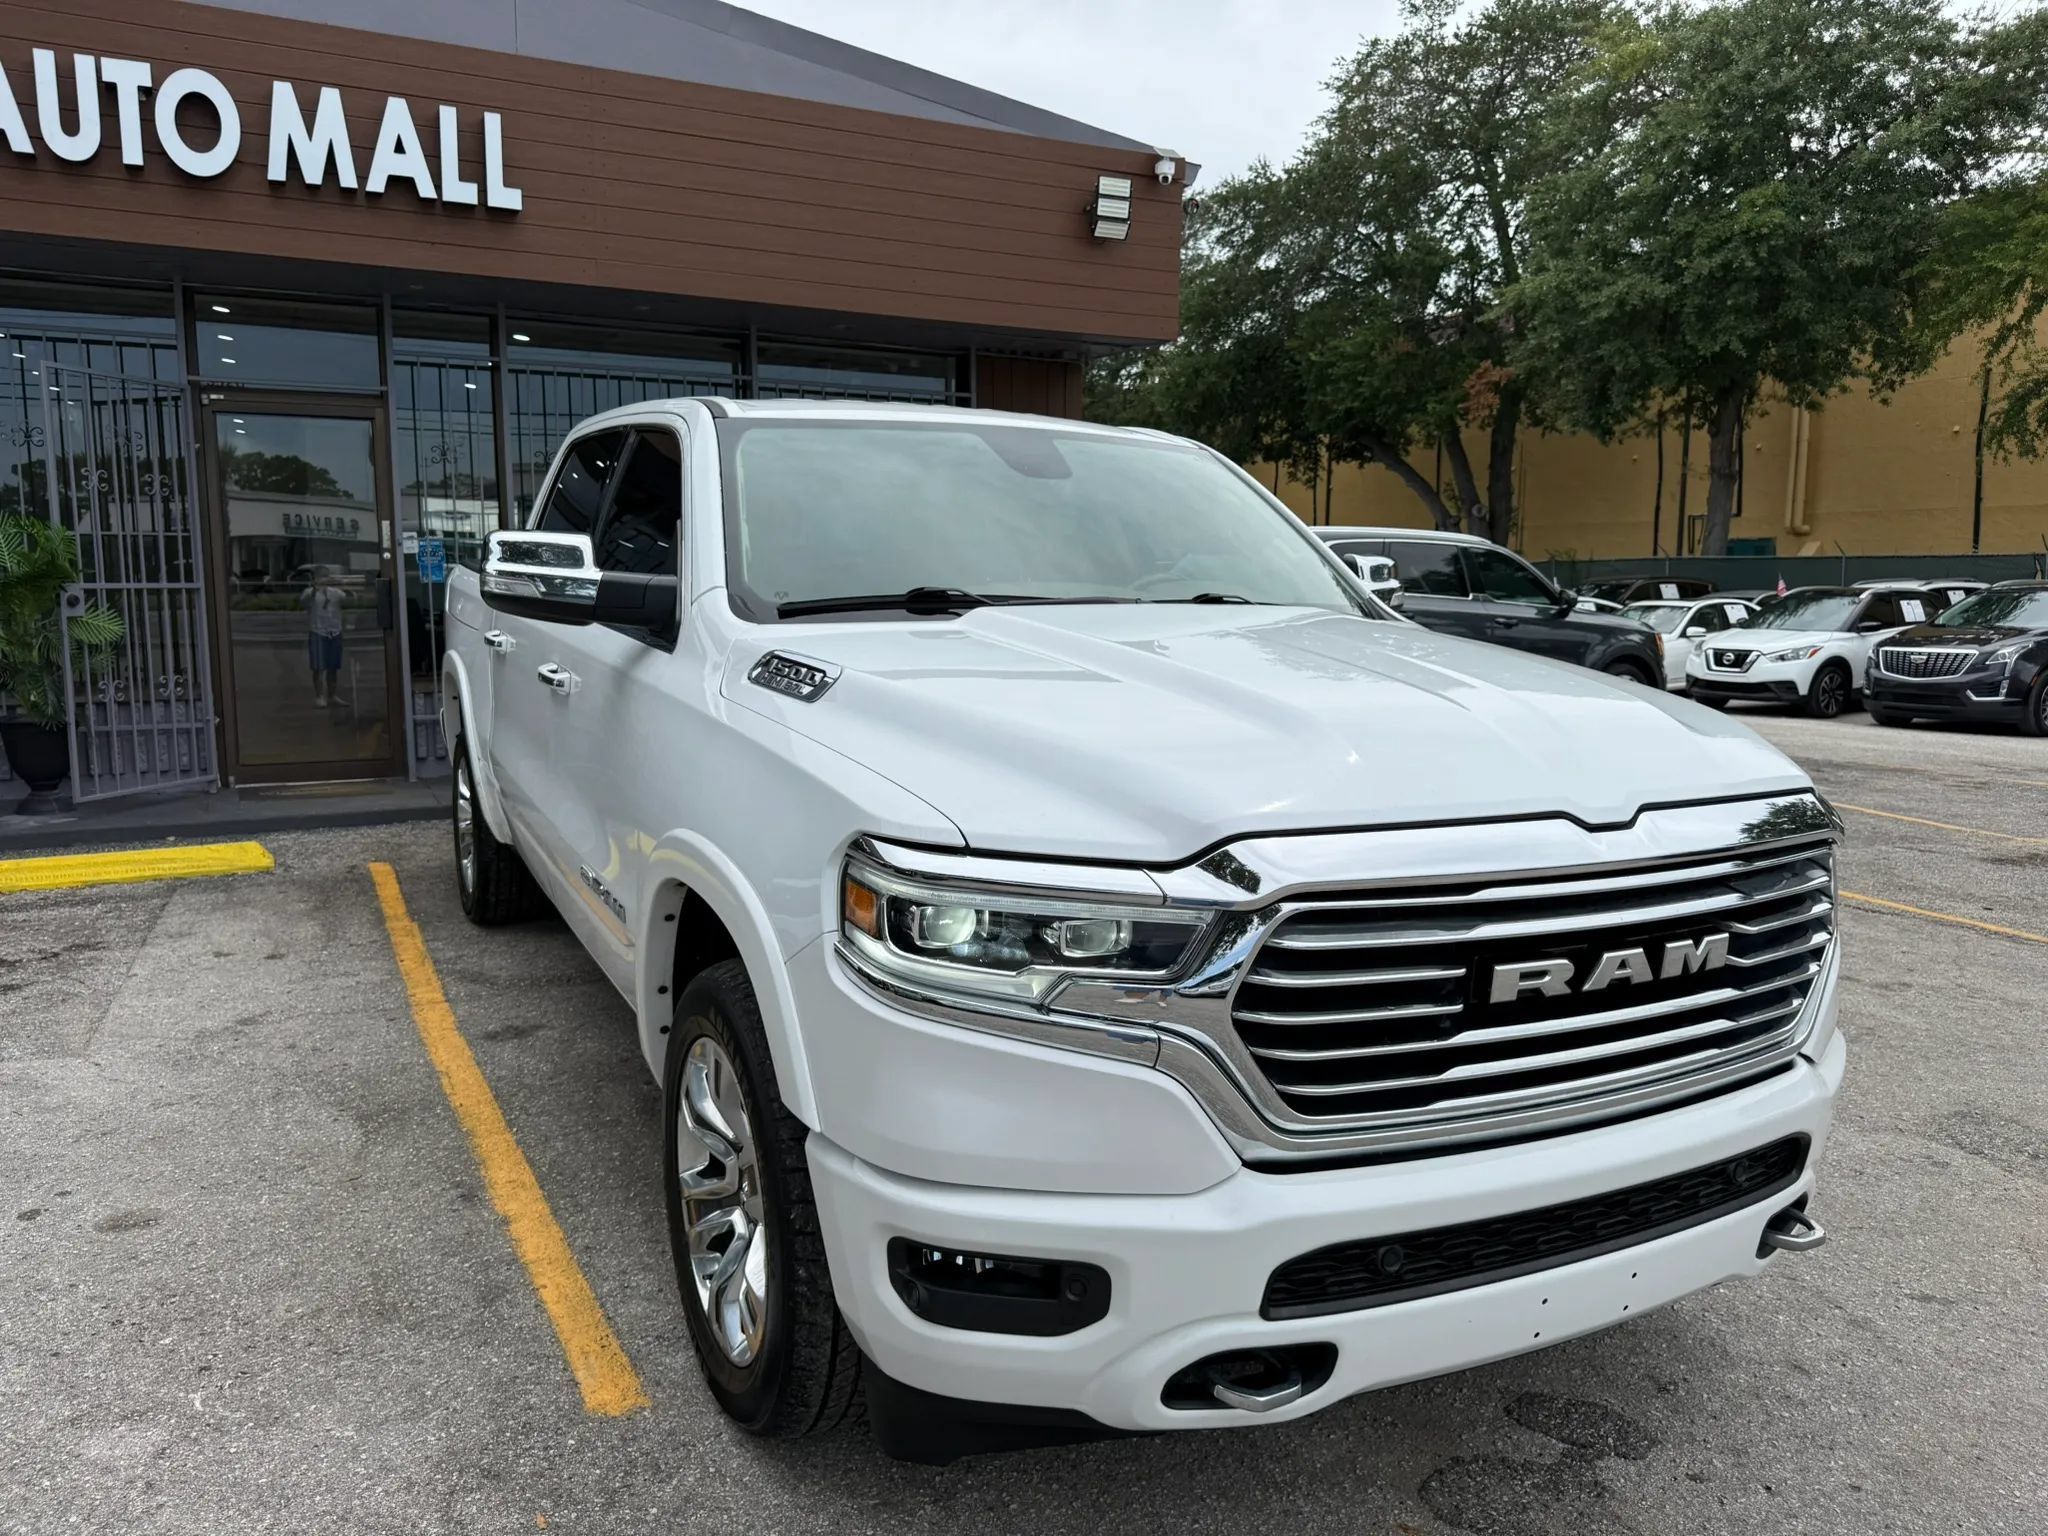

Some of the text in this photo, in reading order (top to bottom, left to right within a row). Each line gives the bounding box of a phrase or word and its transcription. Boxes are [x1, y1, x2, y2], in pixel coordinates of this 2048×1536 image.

[267, 80, 523, 211] MALL
[768, 658, 824, 686] 1500
[1490, 932, 1730, 1004] RAM
